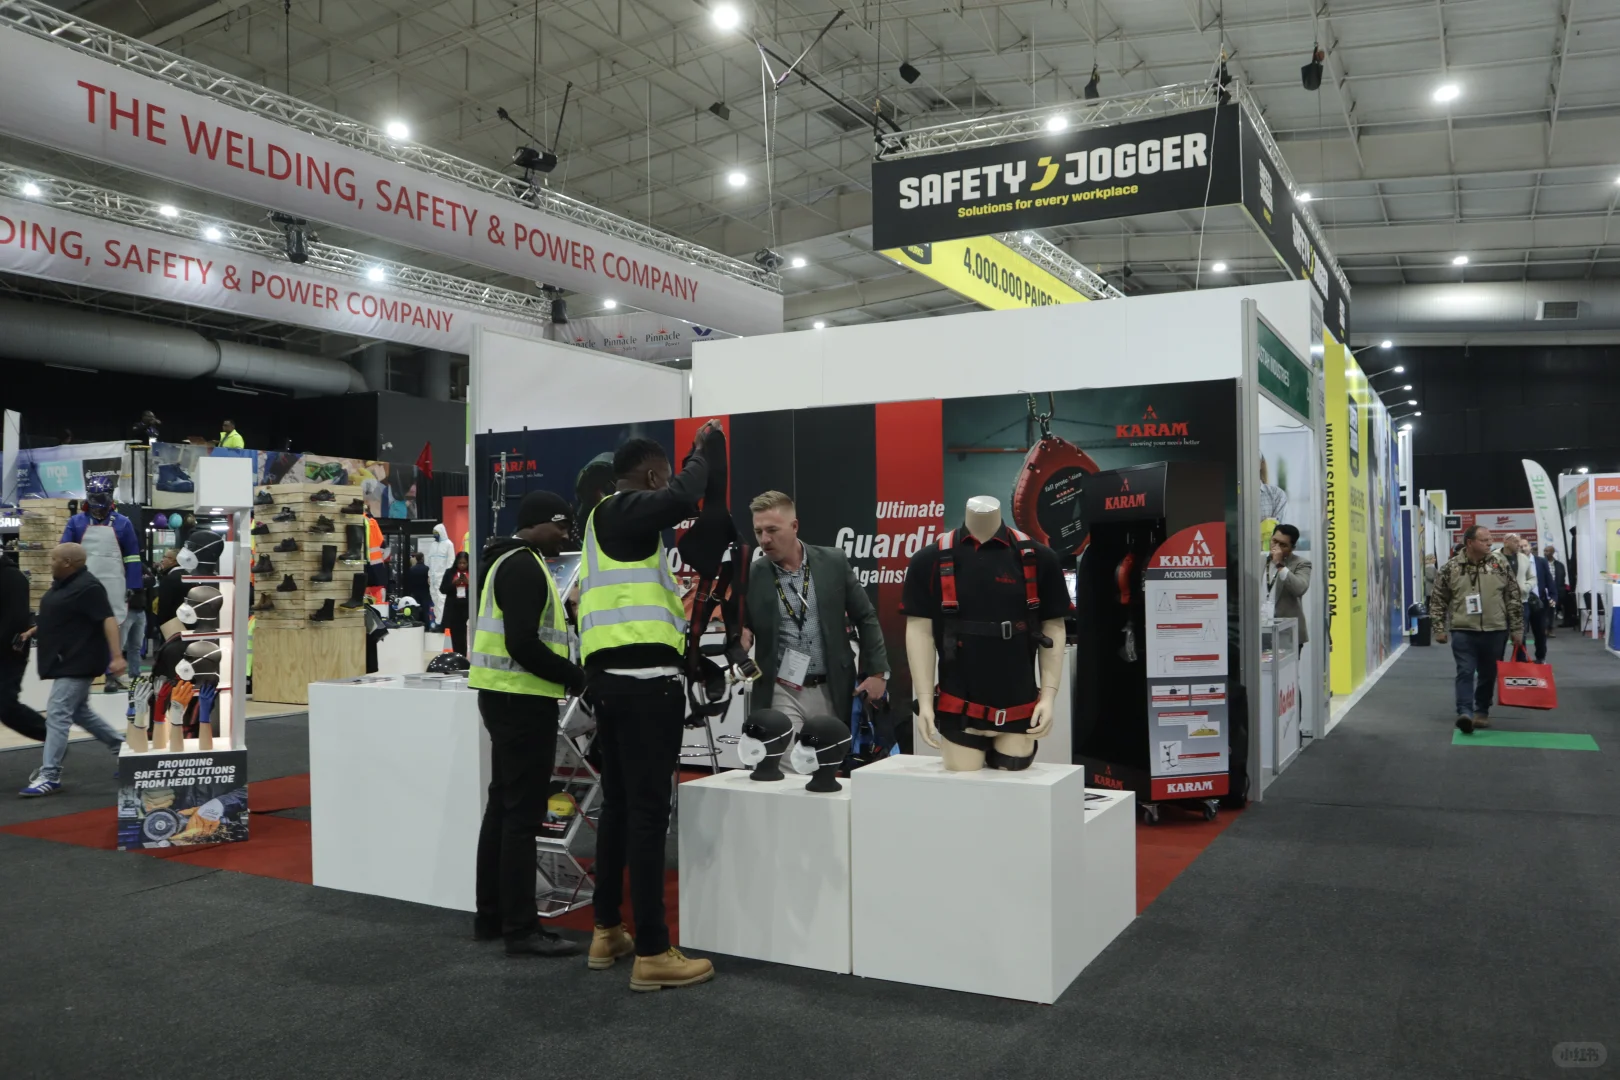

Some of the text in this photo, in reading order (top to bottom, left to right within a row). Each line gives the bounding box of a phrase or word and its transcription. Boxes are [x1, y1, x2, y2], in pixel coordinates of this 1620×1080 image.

[899, 132, 1207, 210] SAFETY JOGGER
[77, 80, 699, 303] THE WELDING, SAFETY & POWER COMPANY
[957, 183, 1139, 219] Solutions for every workplace
[963, 247, 1022, 301] 4.000.000
[104, 239, 214, 286] SAFETY
[222, 264, 242, 292] &
[251, 270, 340, 311] POWER
[346, 291, 453, 333] COMPANY
[603, 335, 637, 347] Pinnacle
[645, 331, 681, 343] Pinnacle
[1116, 422, 1188, 438] KARAM
[1130, 440, 1152, 448] nowing
[1183, 437, 1200, 445] better
[875, 500, 945, 519] Ultimate
[1105, 492, 1147, 510] KARAM
[1325, 423, 1338, 617] WWWSAFETYJOGGERCOM
[835, 525, 945, 558] Guardi
[1160, 555, 1214, 567] KARAM
[1164, 570, 1212, 579] ACCESSORIES
[157, 758, 213, 769] PROVIDING
[134, 765, 236, 780] SAFETY SOLUTIONS
[135, 774, 235, 789] FROM HEAD TO TOE
[1094, 773, 1124, 791] KARAM
[1167, 780, 1213, 793] KARAM
